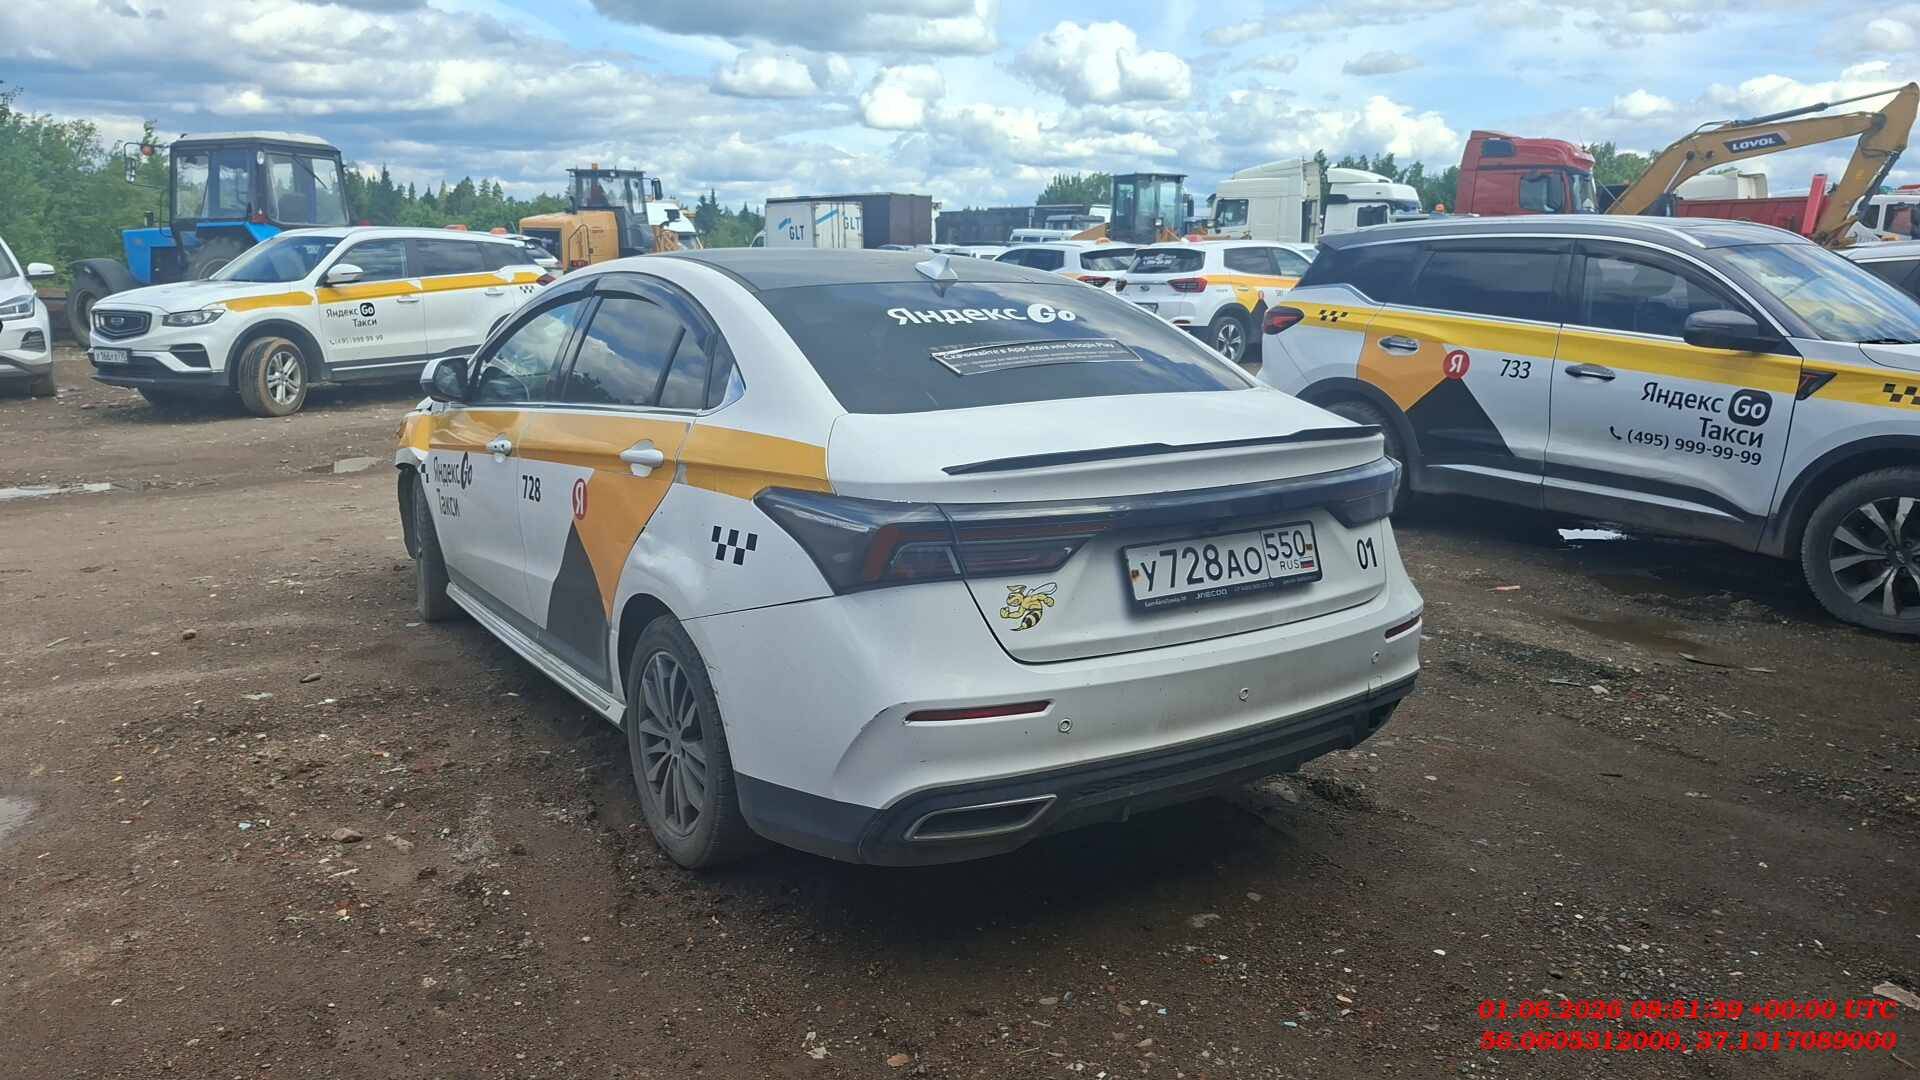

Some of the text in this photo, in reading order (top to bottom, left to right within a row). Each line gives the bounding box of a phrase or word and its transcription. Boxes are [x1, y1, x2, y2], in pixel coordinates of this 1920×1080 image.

[1732, 137, 1776, 151] LOVOL
[789, 225, 804, 240] GLT
[843, 216, 861, 230] GLT
[326, 304, 375, 318] Яндекс Go
[352, 319, 377, 328] Такси
[887, 303, 1077, 325] Яндекс Go
[1448, 354, 1464, 373] Я
[1500, 358, 1532, 379] 733
[1640, 381, 1768, 421] Яндекс Go
[1699, 416, 1764, 449] Такси
[1627, 429, 1762, 466] (495) 999-99-99
[433, 454, 473, 488] Яндекс Go
[522, 474, 541, 502] 728
[574, 480, 585, 515] Я
[436, 488, 461, 518] Такси
[1140, 529, 1306, 593] У728АО 550
[1280, 559, 1299, 571] RUS
[1356, 536, 1378, 571] 01
